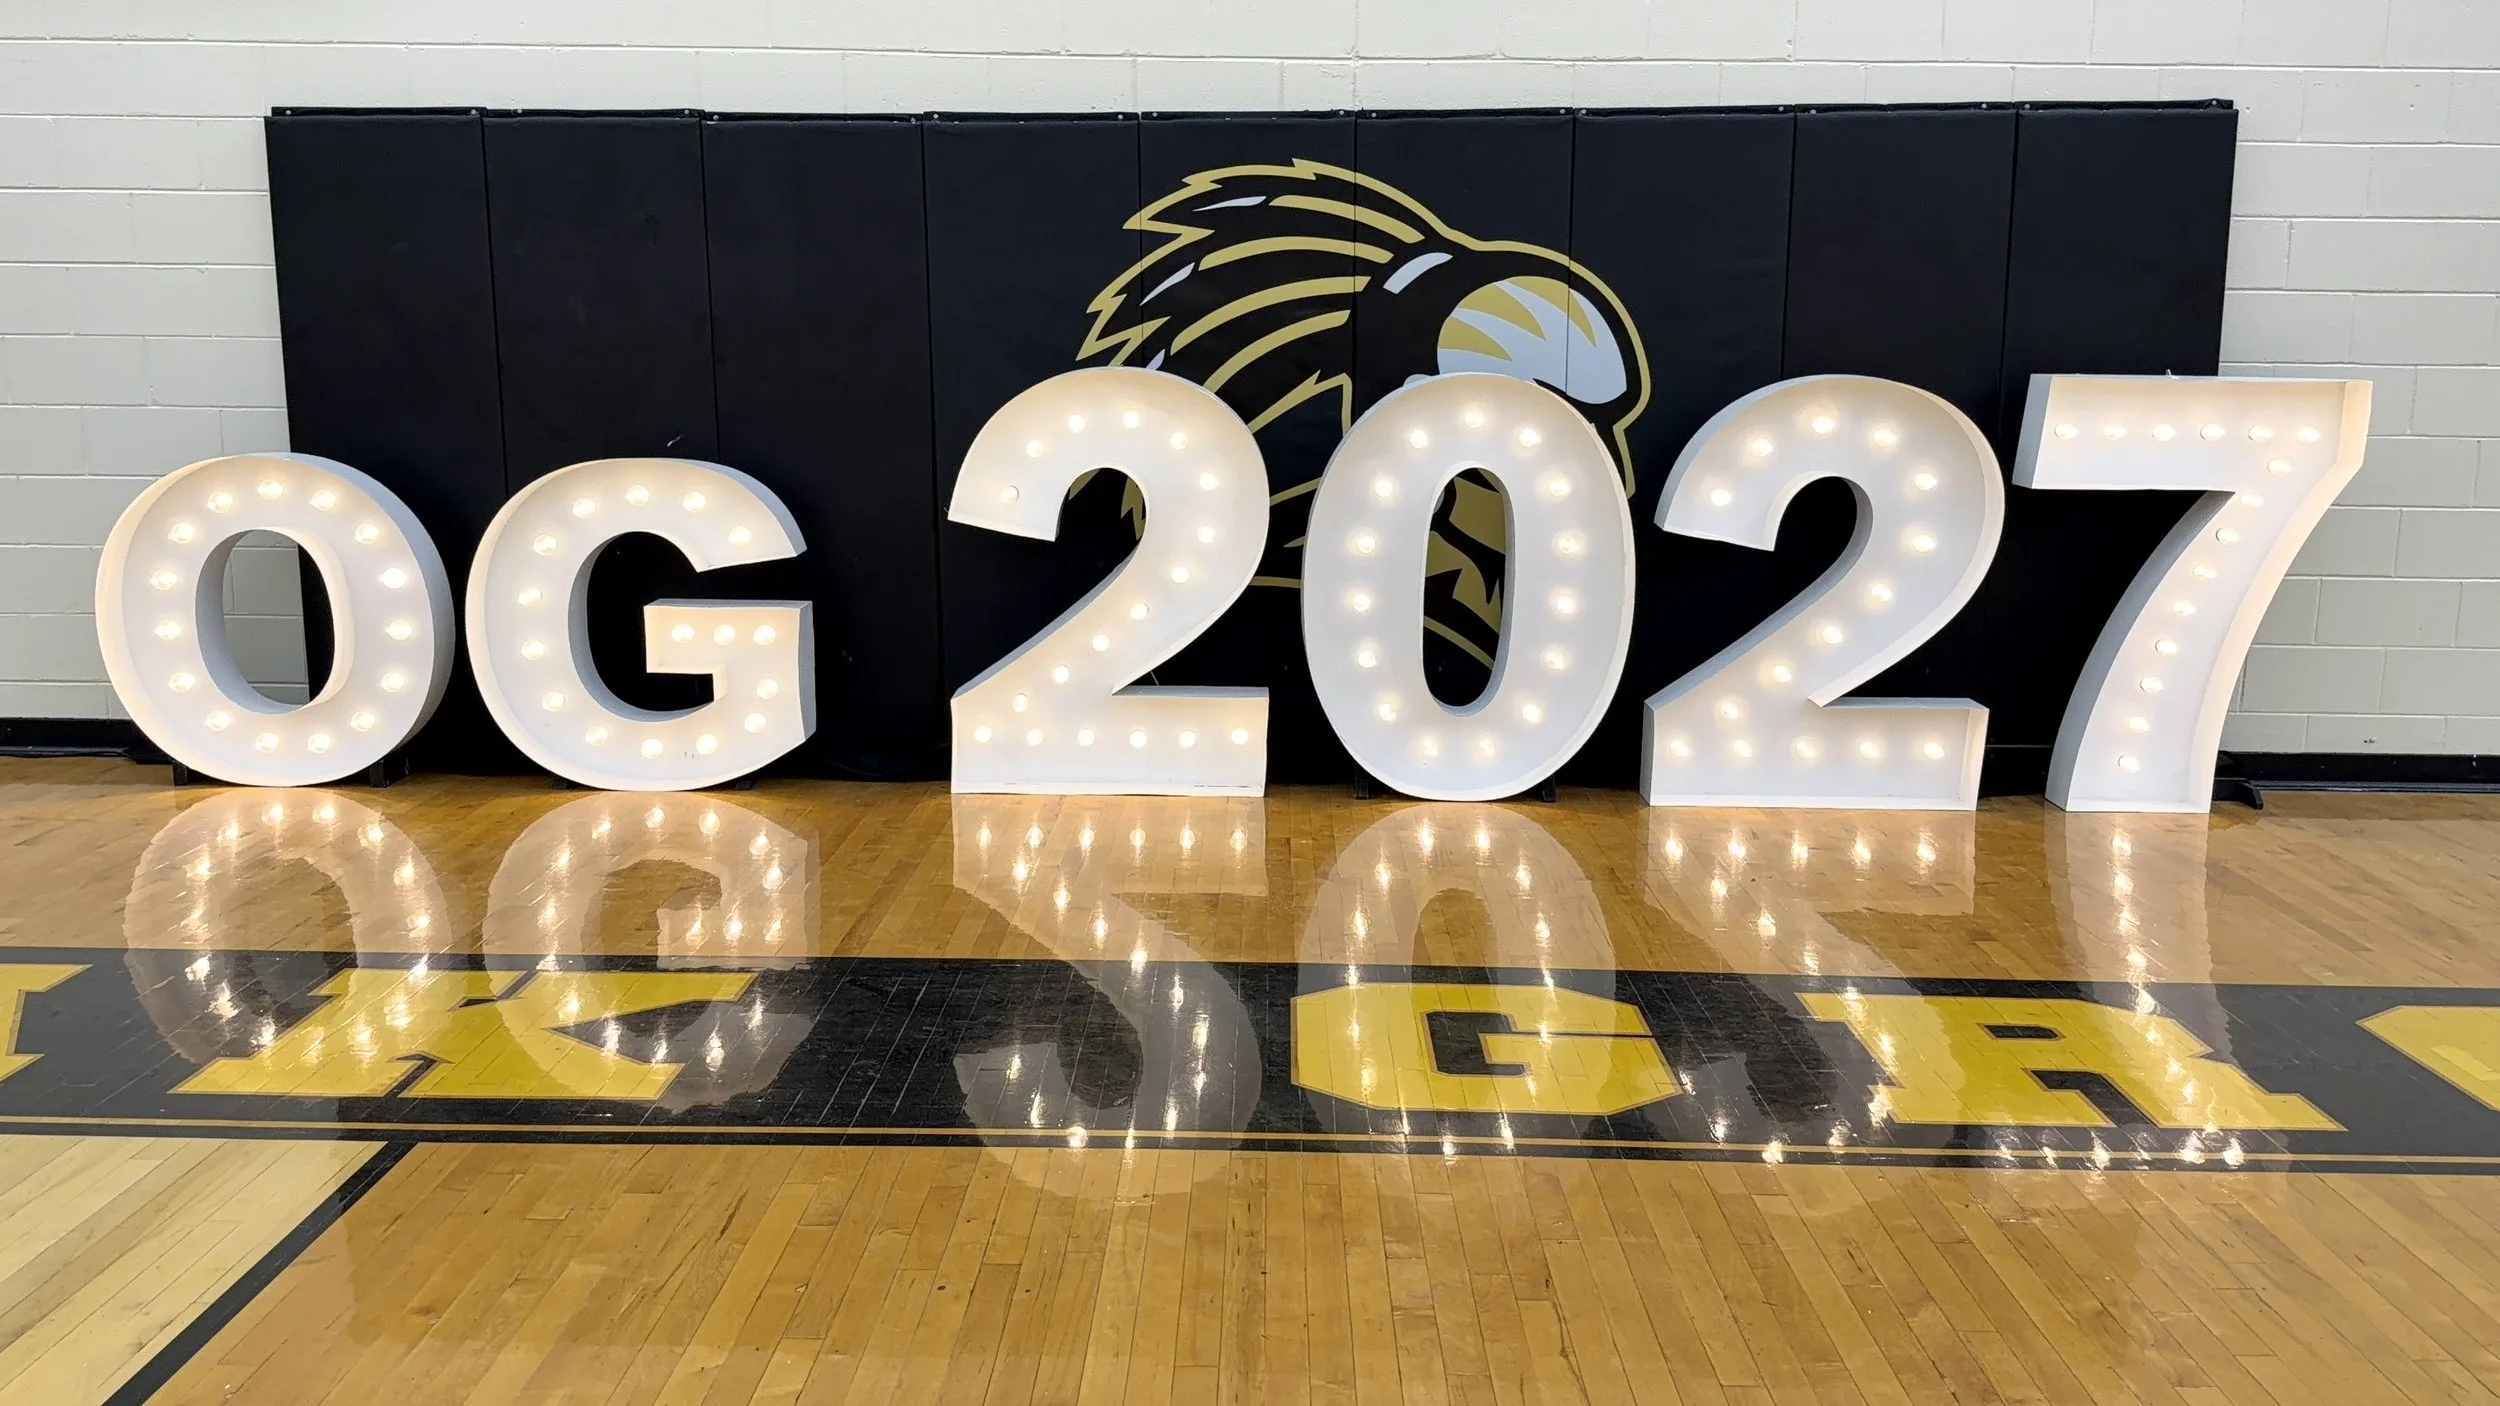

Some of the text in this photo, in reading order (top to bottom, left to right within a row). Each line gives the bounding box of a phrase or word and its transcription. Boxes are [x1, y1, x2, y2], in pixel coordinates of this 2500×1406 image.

[96, 366, 2373, 814] OG 2027
[0, 962, 761, 1100] K
